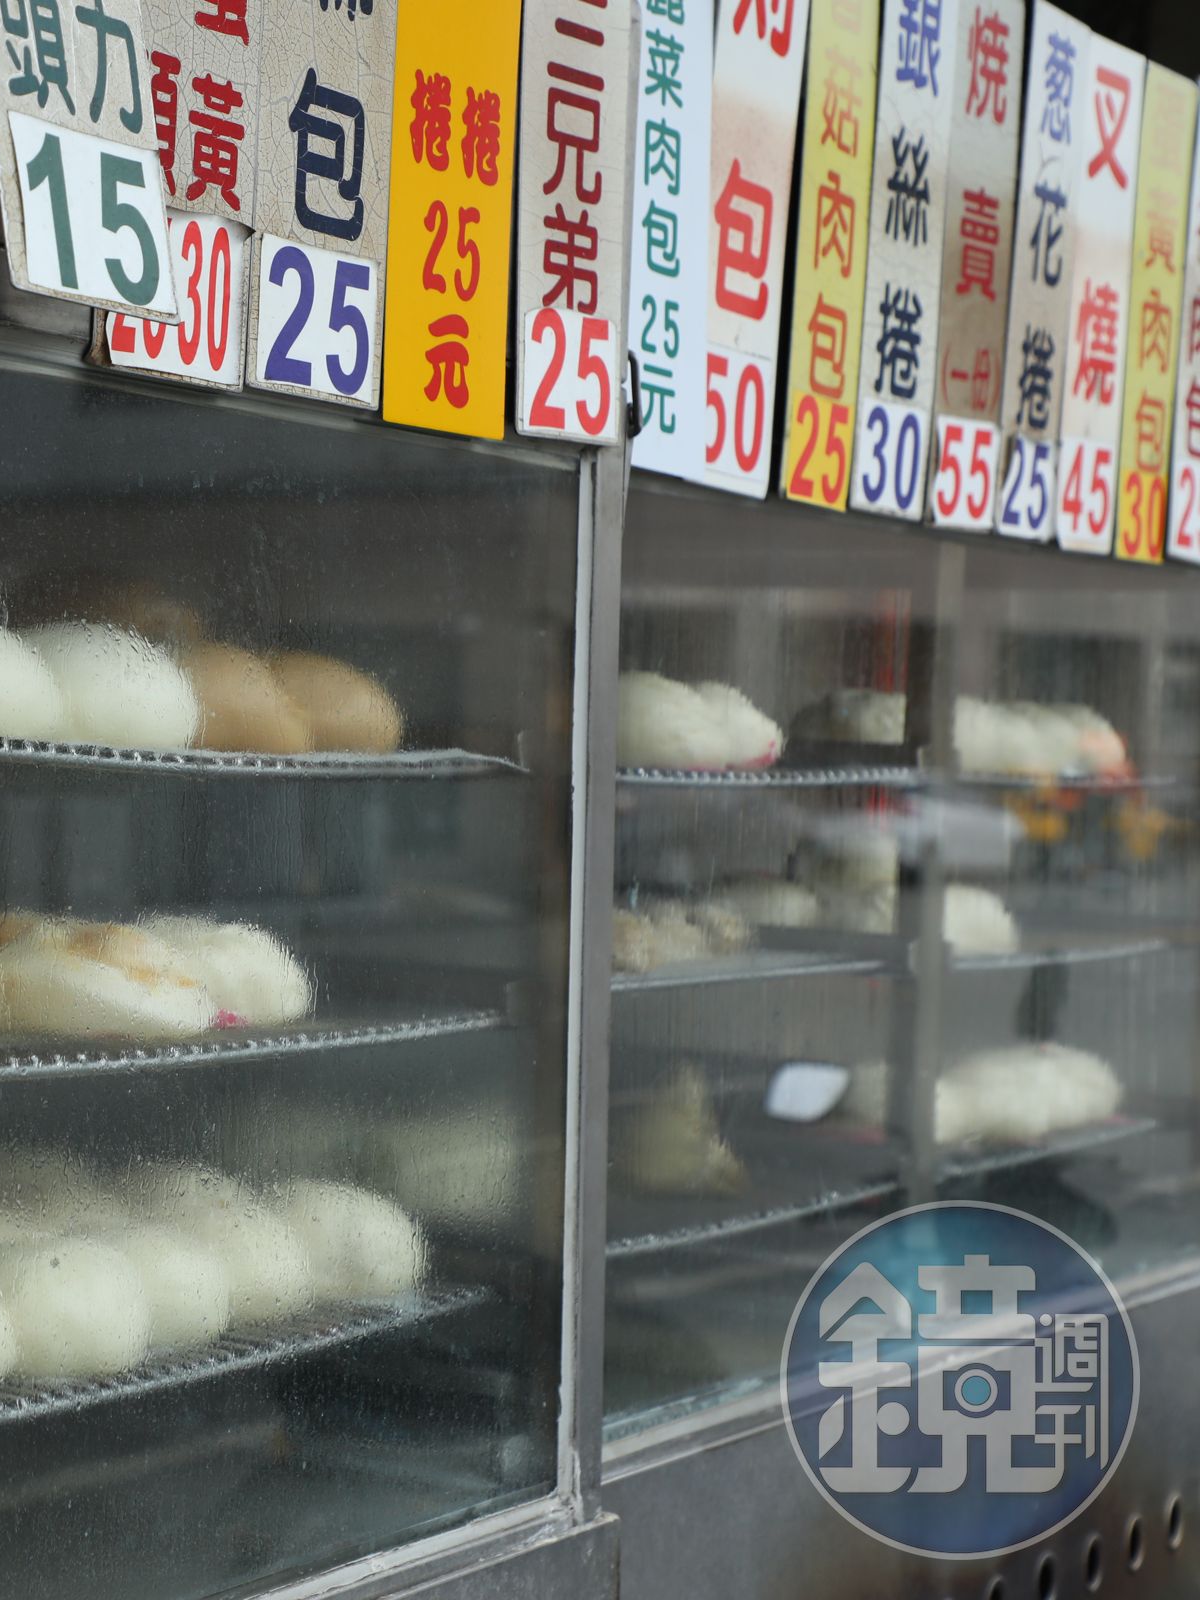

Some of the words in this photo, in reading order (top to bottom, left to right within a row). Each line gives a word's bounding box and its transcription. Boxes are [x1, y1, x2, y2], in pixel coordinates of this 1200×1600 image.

[74, 0, 143, 134] 力
[288, 67, 365, 241] 包
[642, 0, 686, 278] 菜肉包
[26, 132, 160, 306] 15
[422, 199, 481, 302] 25
[177, 220, 231, 371] 30
[264, 245, 371, 395] 25
[641, 294, 680, 359] 25
[424, 314, 470, 408] 元
[528, 307, 611, 436] 25
[640, 363, 676, 435] 元
[706, 352, 765, 473] 50
[789, 394, 850, 504] 25
[862, 405, 922, 511] 30
[937, 424, 993, 520] 55
[1002, 436, 1049, 531] 25
[1062, 443, 1112, 536] 45
[1123, 470, 1165, 557] 30
